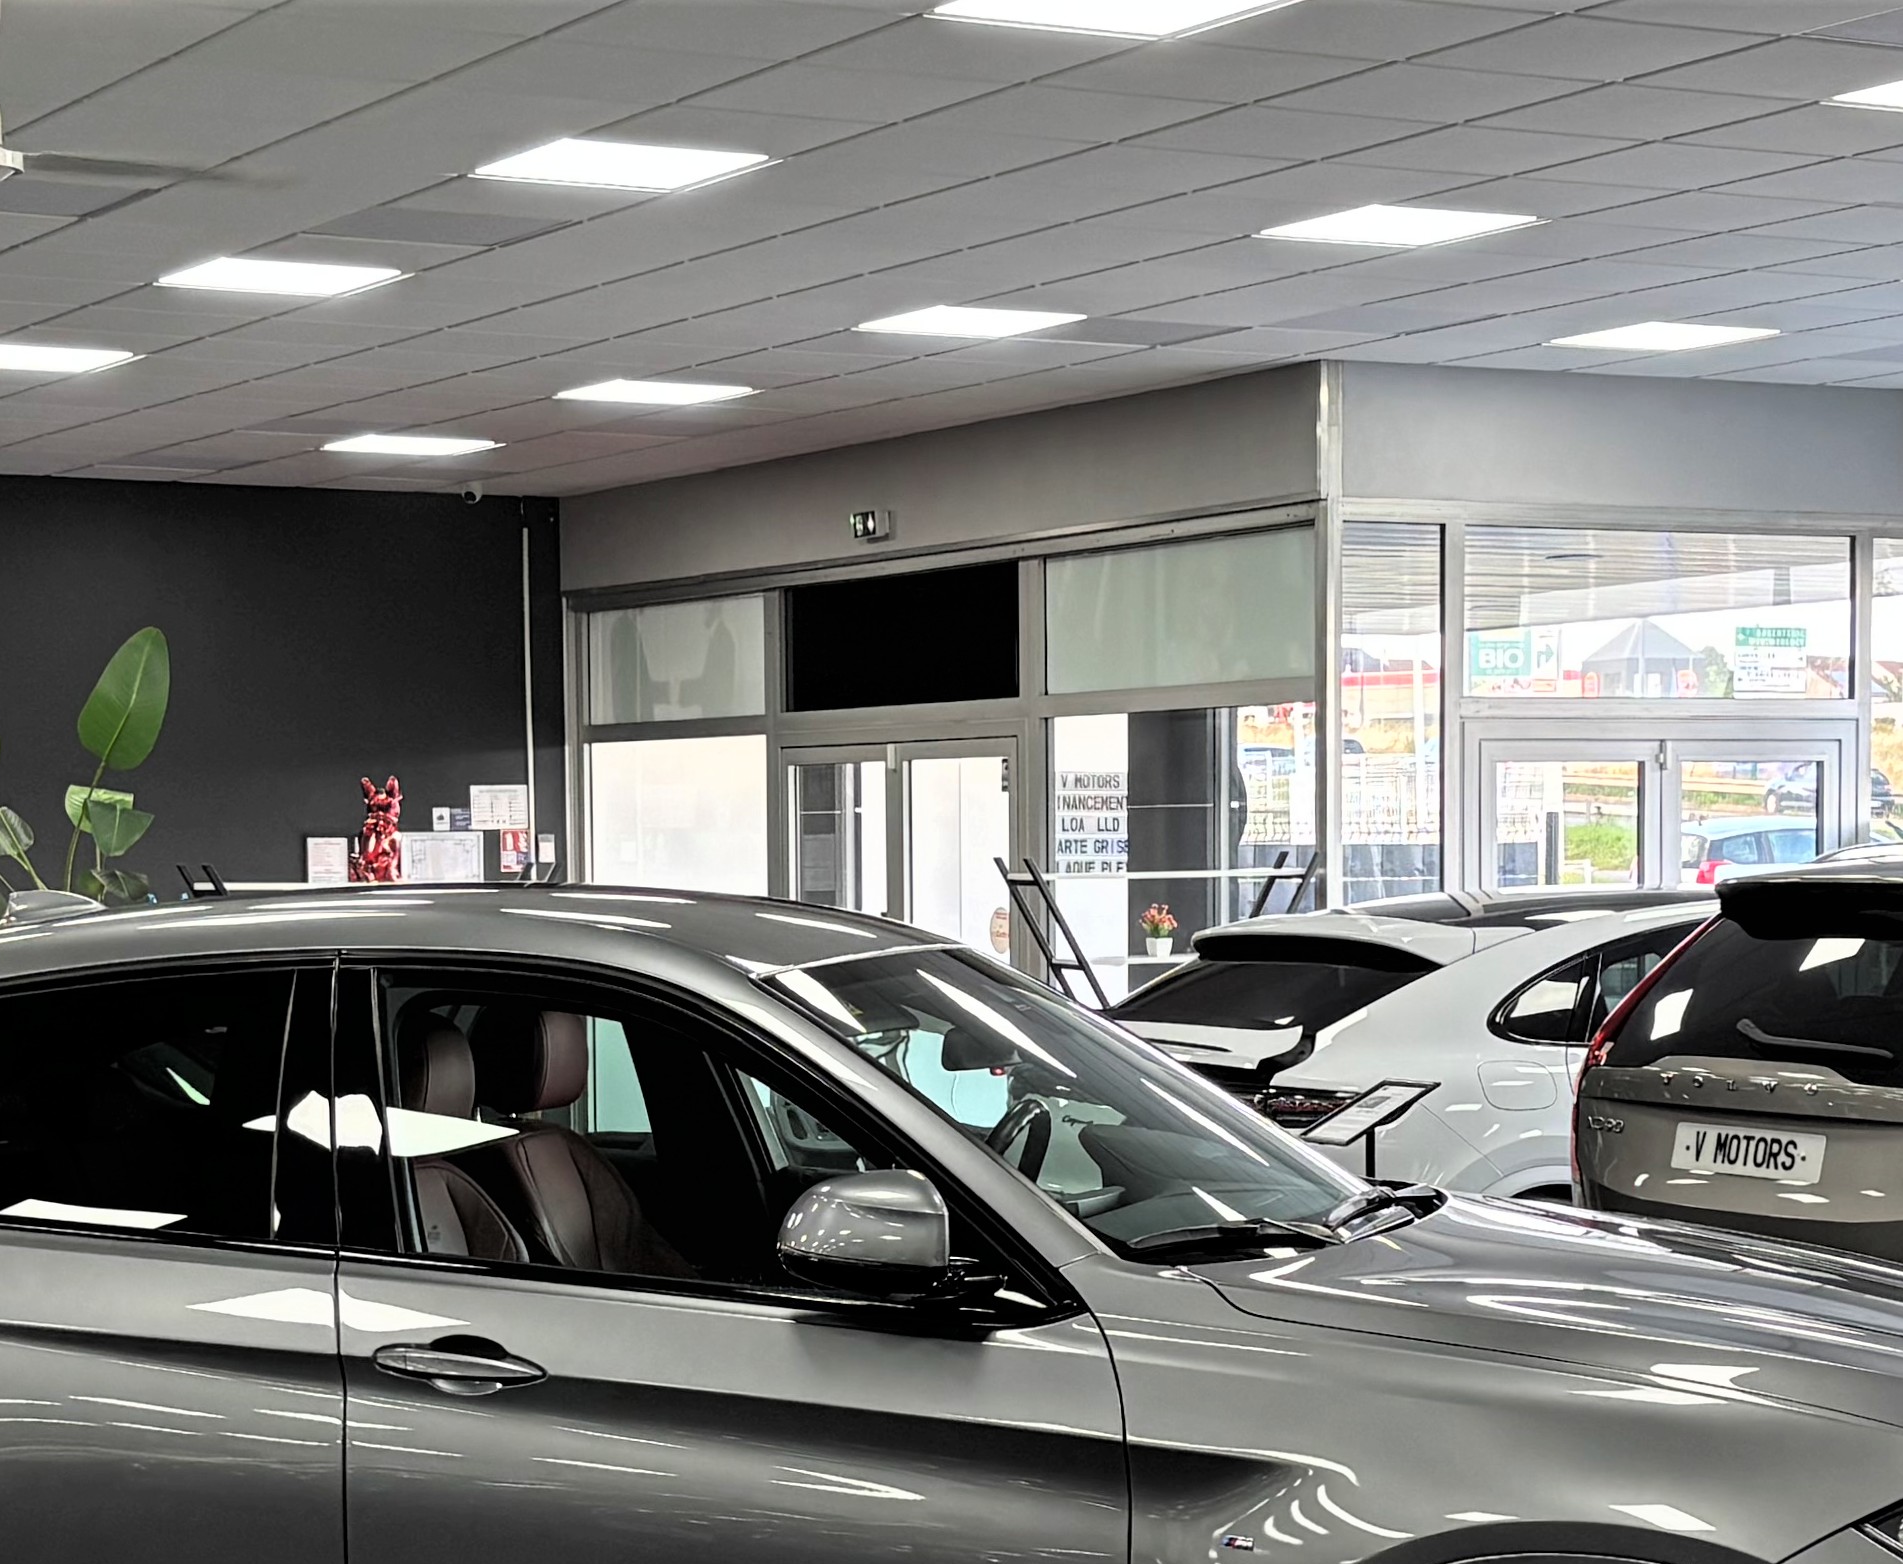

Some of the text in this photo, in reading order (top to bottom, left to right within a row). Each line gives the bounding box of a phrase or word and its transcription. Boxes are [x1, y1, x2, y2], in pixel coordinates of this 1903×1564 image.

[1478, 648, 1524, 669] BIO
[1060, 774, 1120, 789] V MOTORS
[1061, 817, 1120, 832] LOA LLD
[1695, 1131, 1798, 1171] V MOTORS
